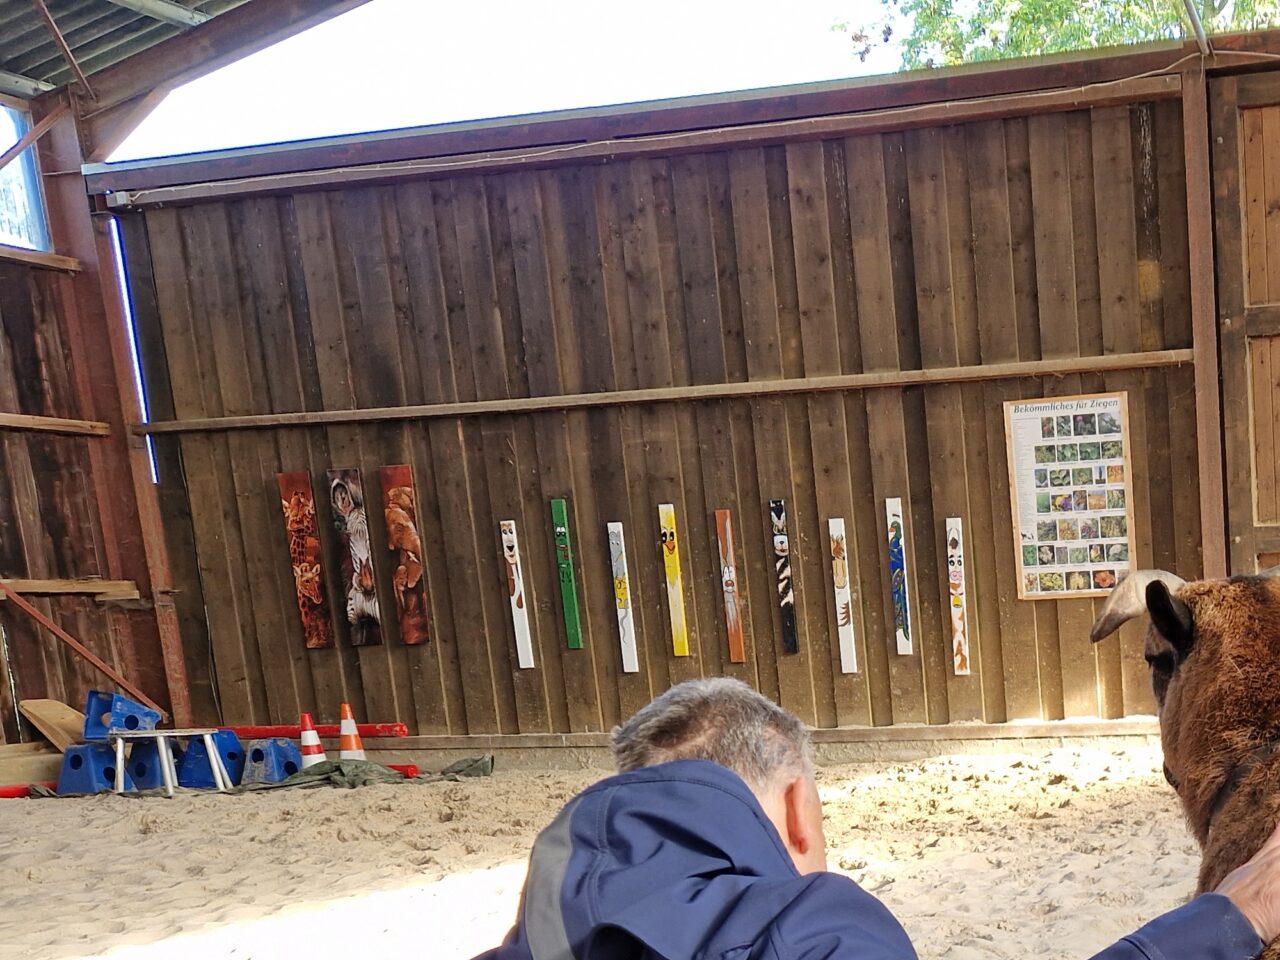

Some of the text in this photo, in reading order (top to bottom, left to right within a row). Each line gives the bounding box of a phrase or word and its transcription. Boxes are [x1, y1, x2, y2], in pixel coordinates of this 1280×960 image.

[1014, 399, 1118, 413] Bekömmliches für Ziegen
